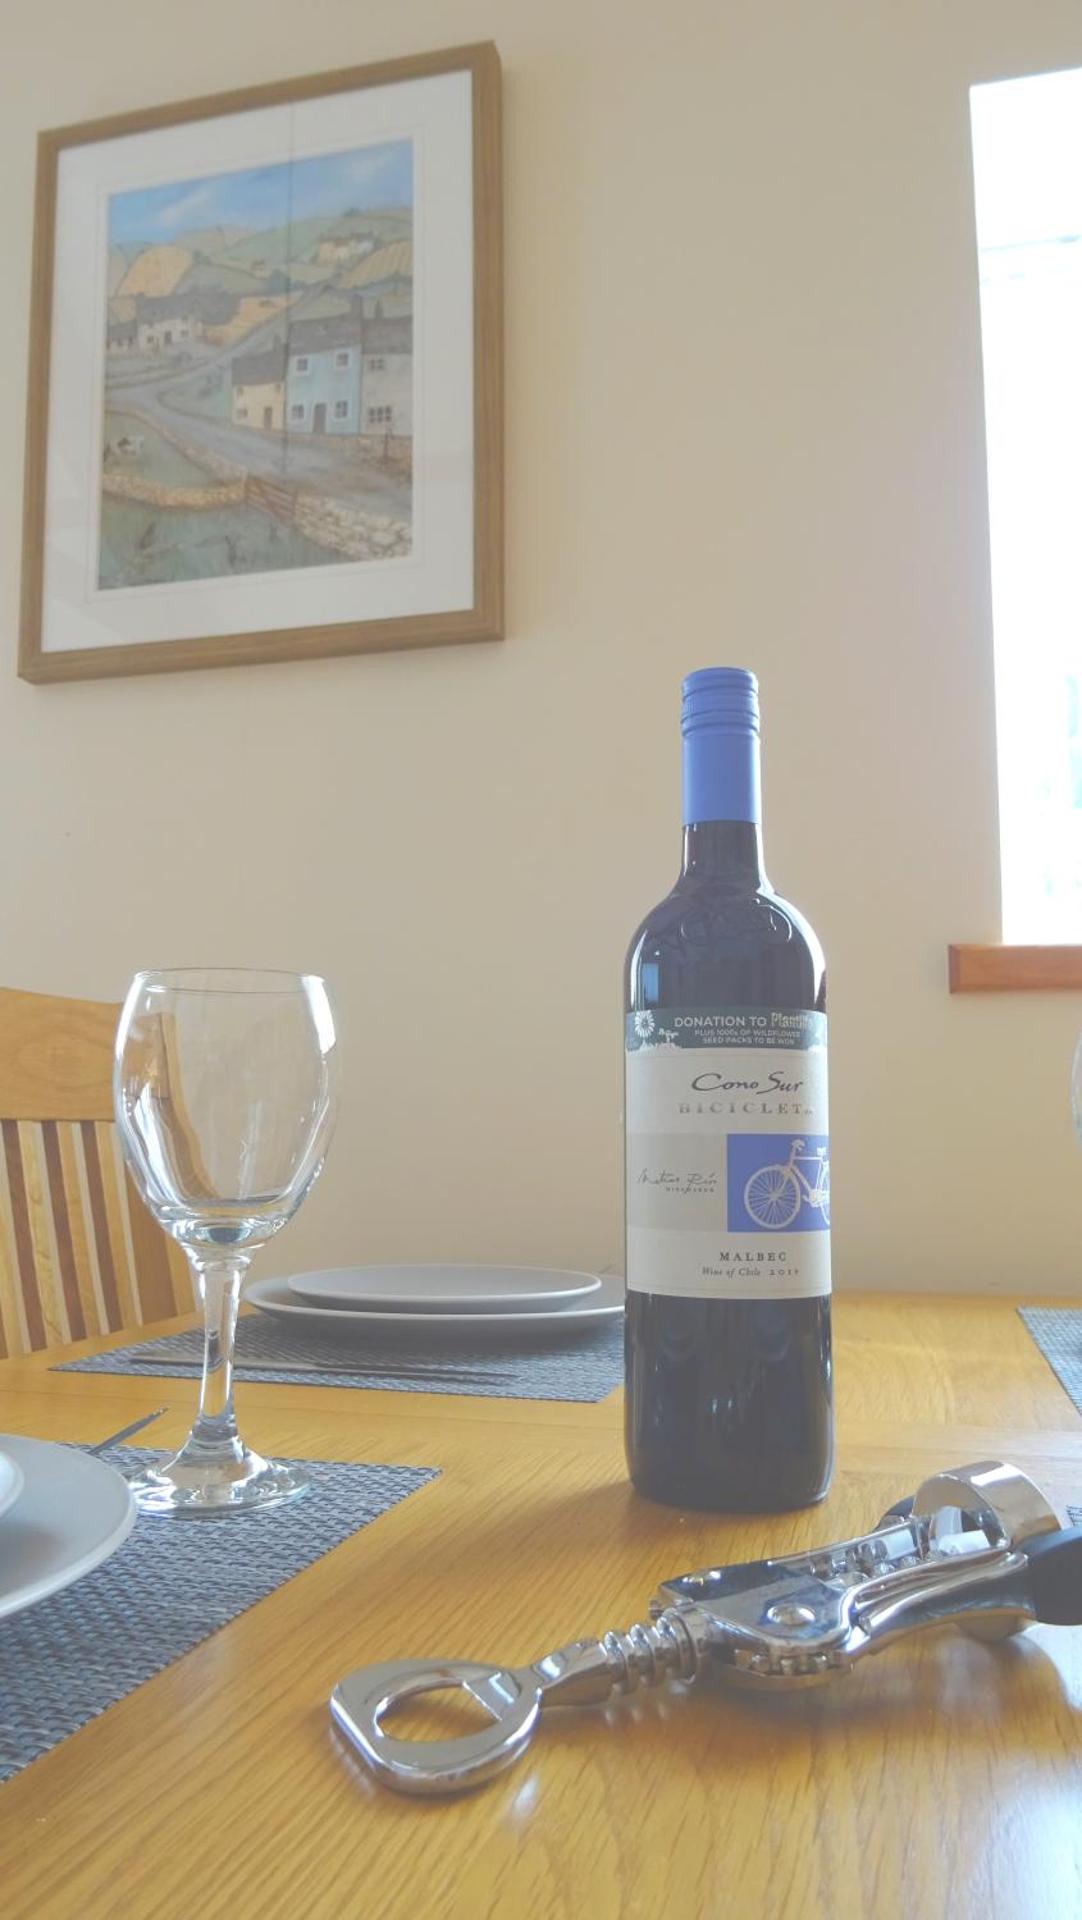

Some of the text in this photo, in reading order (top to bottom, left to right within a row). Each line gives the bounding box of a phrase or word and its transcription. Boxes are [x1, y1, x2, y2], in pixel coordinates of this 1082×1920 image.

[674, 1016, 745, 1028] DONATION
[749, 1016, 767, 1028] TO
[691, 1071, 803, 1095] Cono Sur
[719, 1252, 787, 1262] MALBEC
[702, 1267, 723, 1276] Wine
[726, 1268, 736, 1278] of
